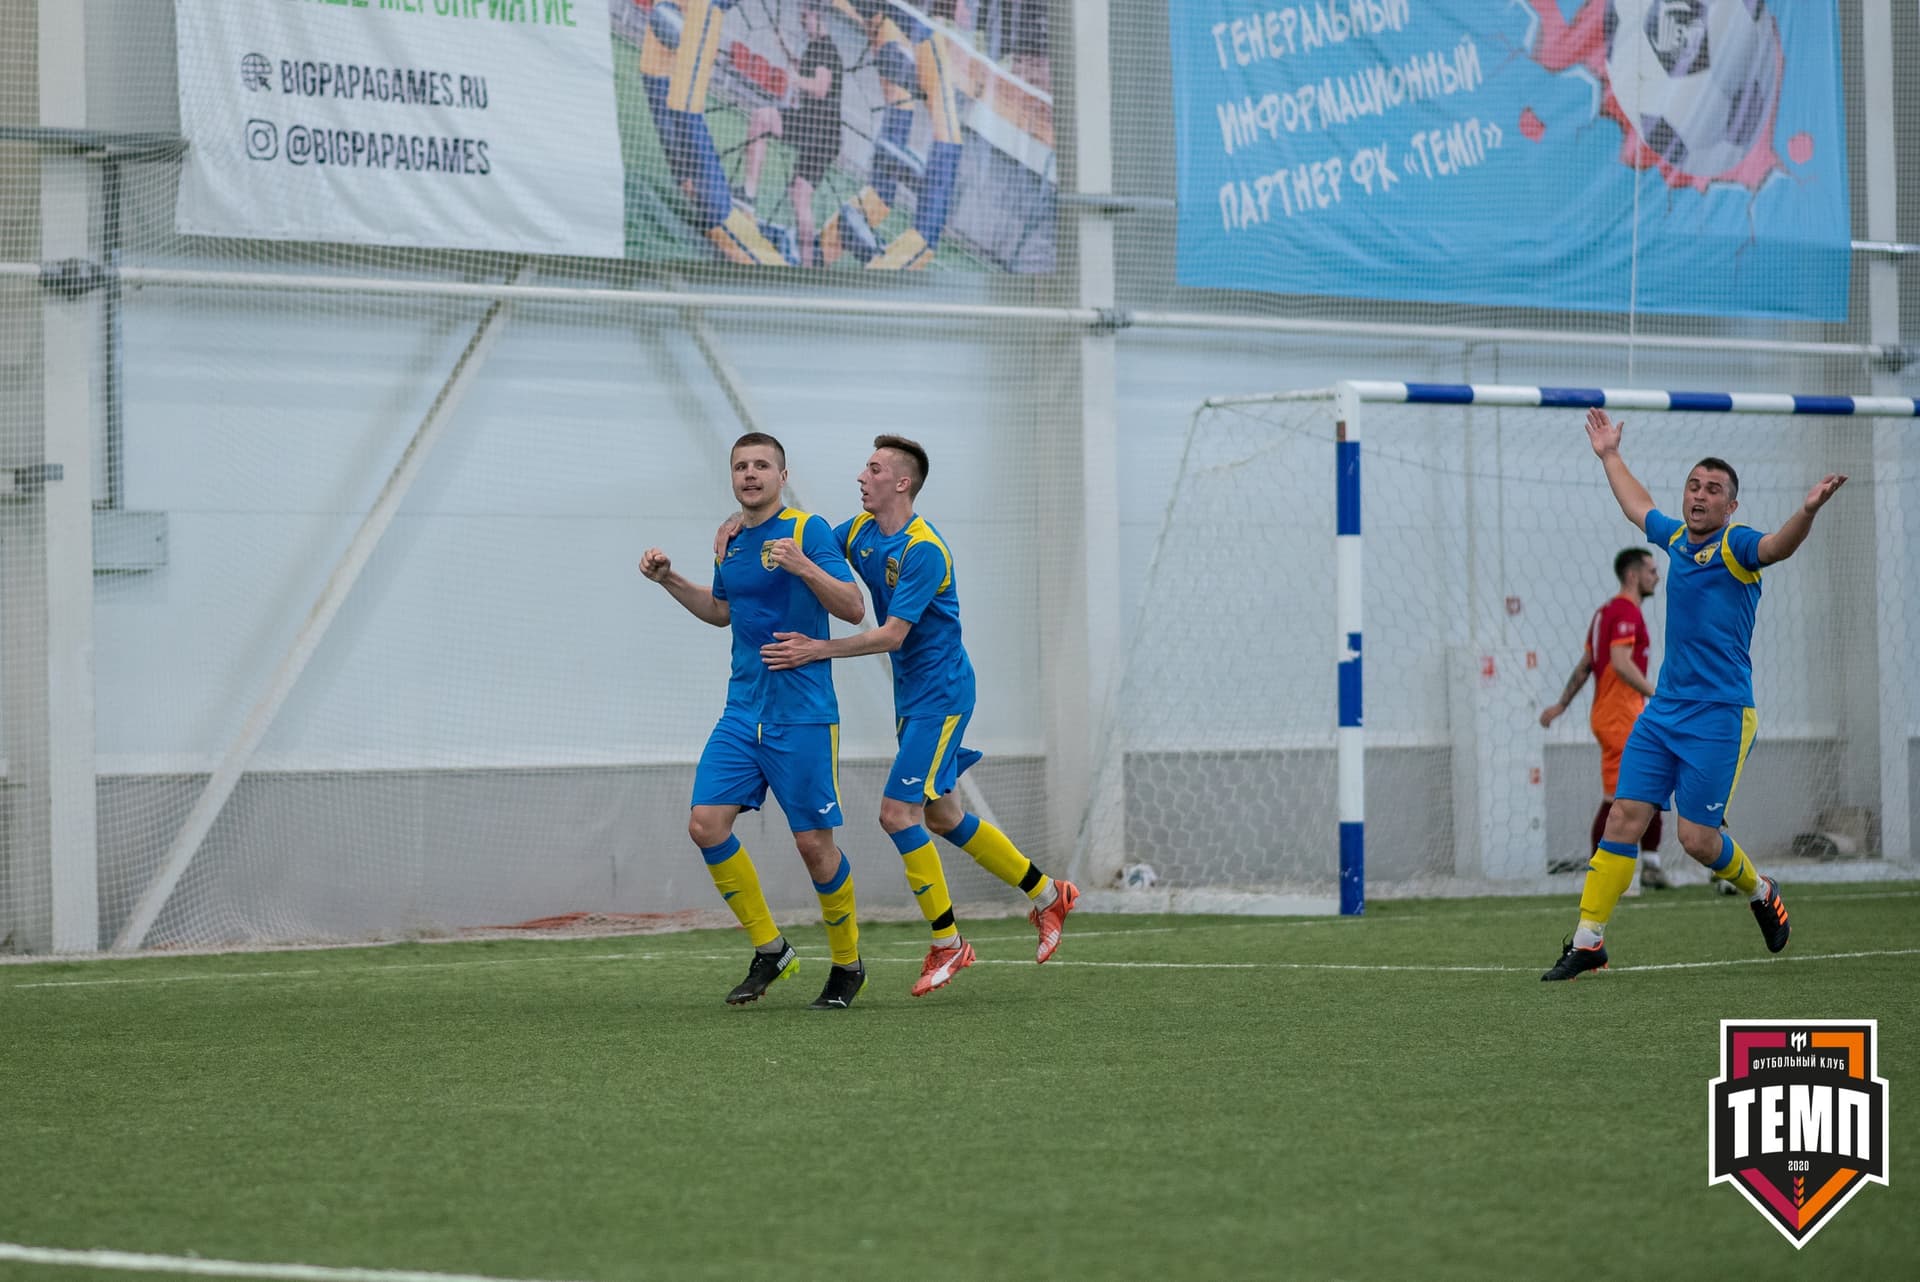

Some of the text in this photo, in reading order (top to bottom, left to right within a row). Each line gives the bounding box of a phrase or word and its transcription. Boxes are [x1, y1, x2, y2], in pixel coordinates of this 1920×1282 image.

[279, 59, 488, 110] BIGPAPAGAMES.RU
[1216, 33, 1483, 155] ИНФОРМАЦИОННЫЙ
[286, 124, 491, 175] @BIGPAPAGAMES
[1218, 117, 1503, 232] ПАРТНЕР ФК «ТЕМП»
